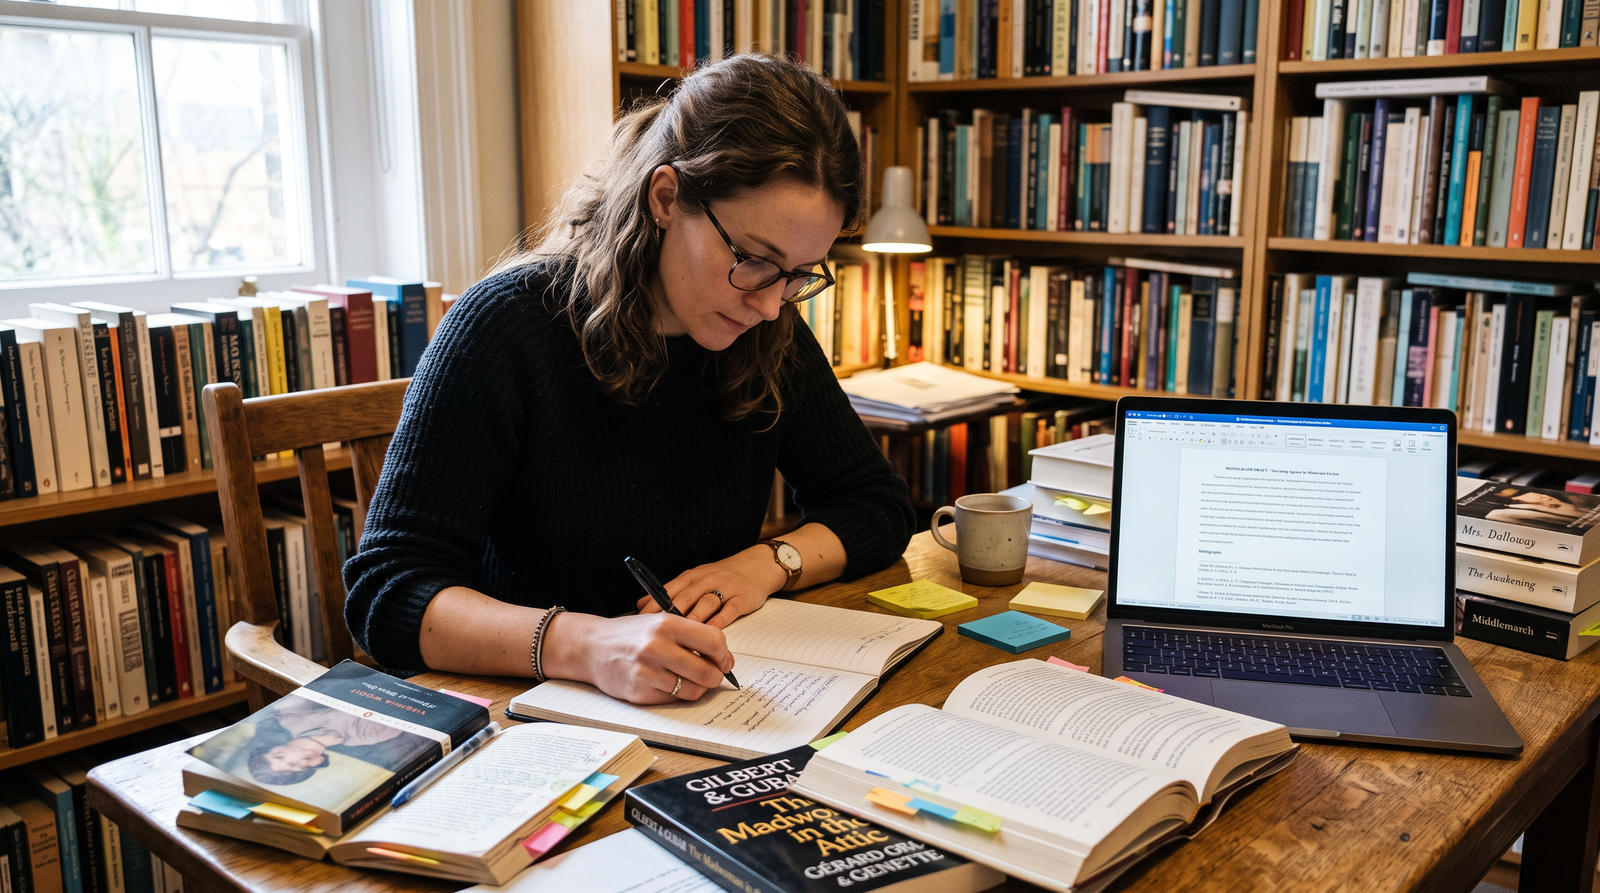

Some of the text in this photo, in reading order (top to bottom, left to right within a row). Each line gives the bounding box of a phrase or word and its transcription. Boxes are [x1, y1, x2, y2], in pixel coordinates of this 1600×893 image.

[1461, 524, 1537, 550] Mrs. Dalloway
[1468, 566, 1537, 592] The Awakening
[1472, 613, 1535, 636] Middlemarch
[686, 758, 795, 792] GILBERT
[703, 771, 803, 805] & GUBA
[759, 796, 816, 814] Th
[786, 826, 824, 844] in
[816, 829, 889, 858] Attic
[804, 849, 885, 880] GÉRARD
[836, 849, 945, 888] & GENETTE
